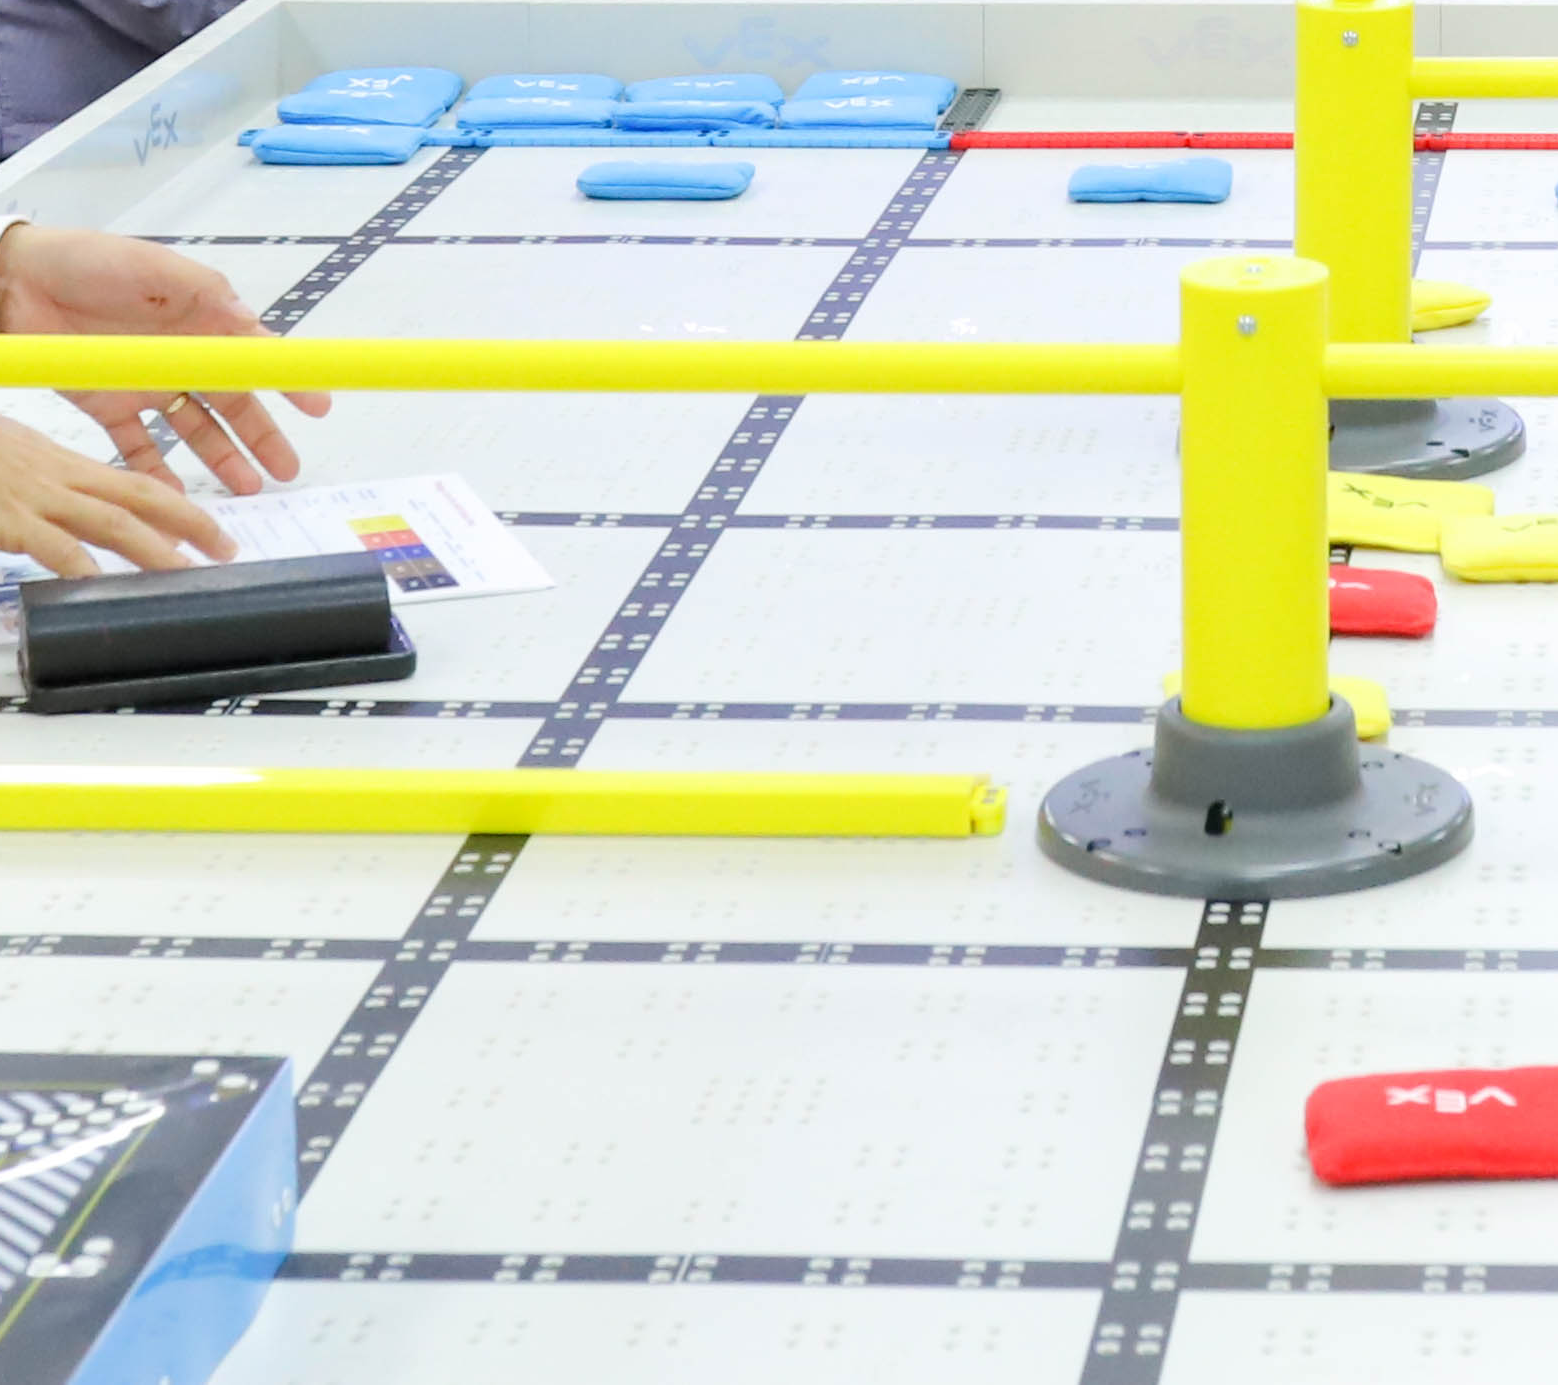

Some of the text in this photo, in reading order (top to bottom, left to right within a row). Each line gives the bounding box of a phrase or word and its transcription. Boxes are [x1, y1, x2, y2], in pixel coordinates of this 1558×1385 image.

[682, 16, 835, 68] VEX
[824, 95, 894, 108] VEX
[1342, 482, 1430, 510] VEX
[1386, 1084, 1518, 1114] VEX
